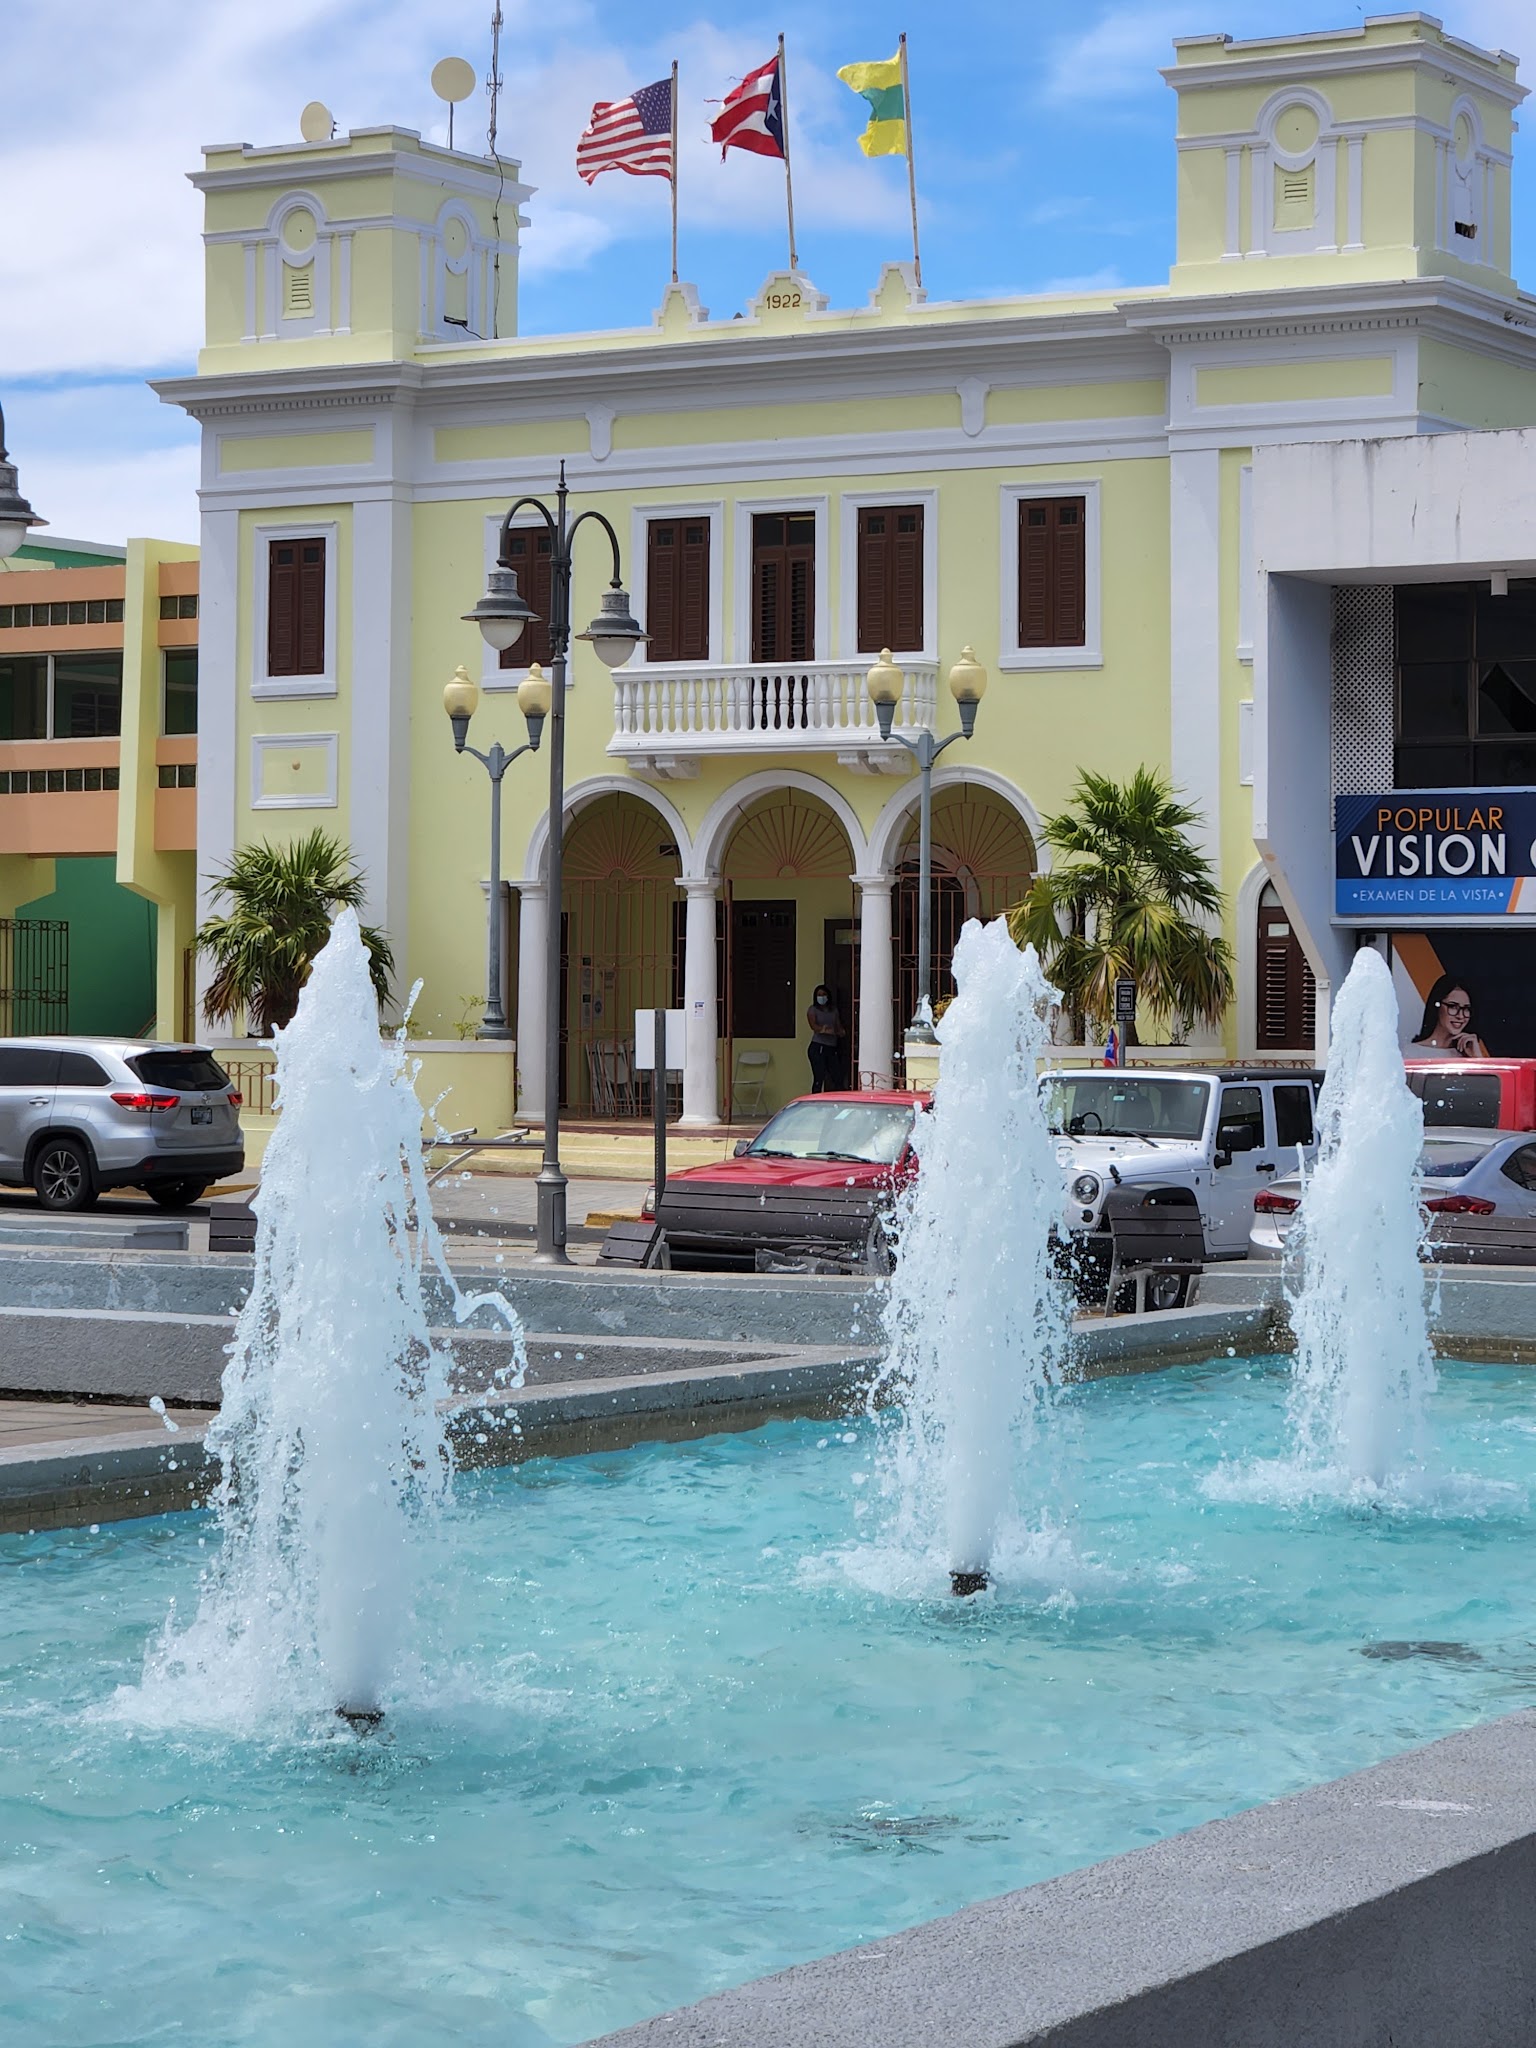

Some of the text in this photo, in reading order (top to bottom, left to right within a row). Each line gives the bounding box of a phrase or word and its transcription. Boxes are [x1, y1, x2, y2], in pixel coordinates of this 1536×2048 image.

[766, 293, 801, 309] 1922
[1377, 806, 1504, 832] POPULAR
[1351, 833, 1506, 876] VISION
[1359, 889, 1497, 902] EXAMEN DE LA VISTA
